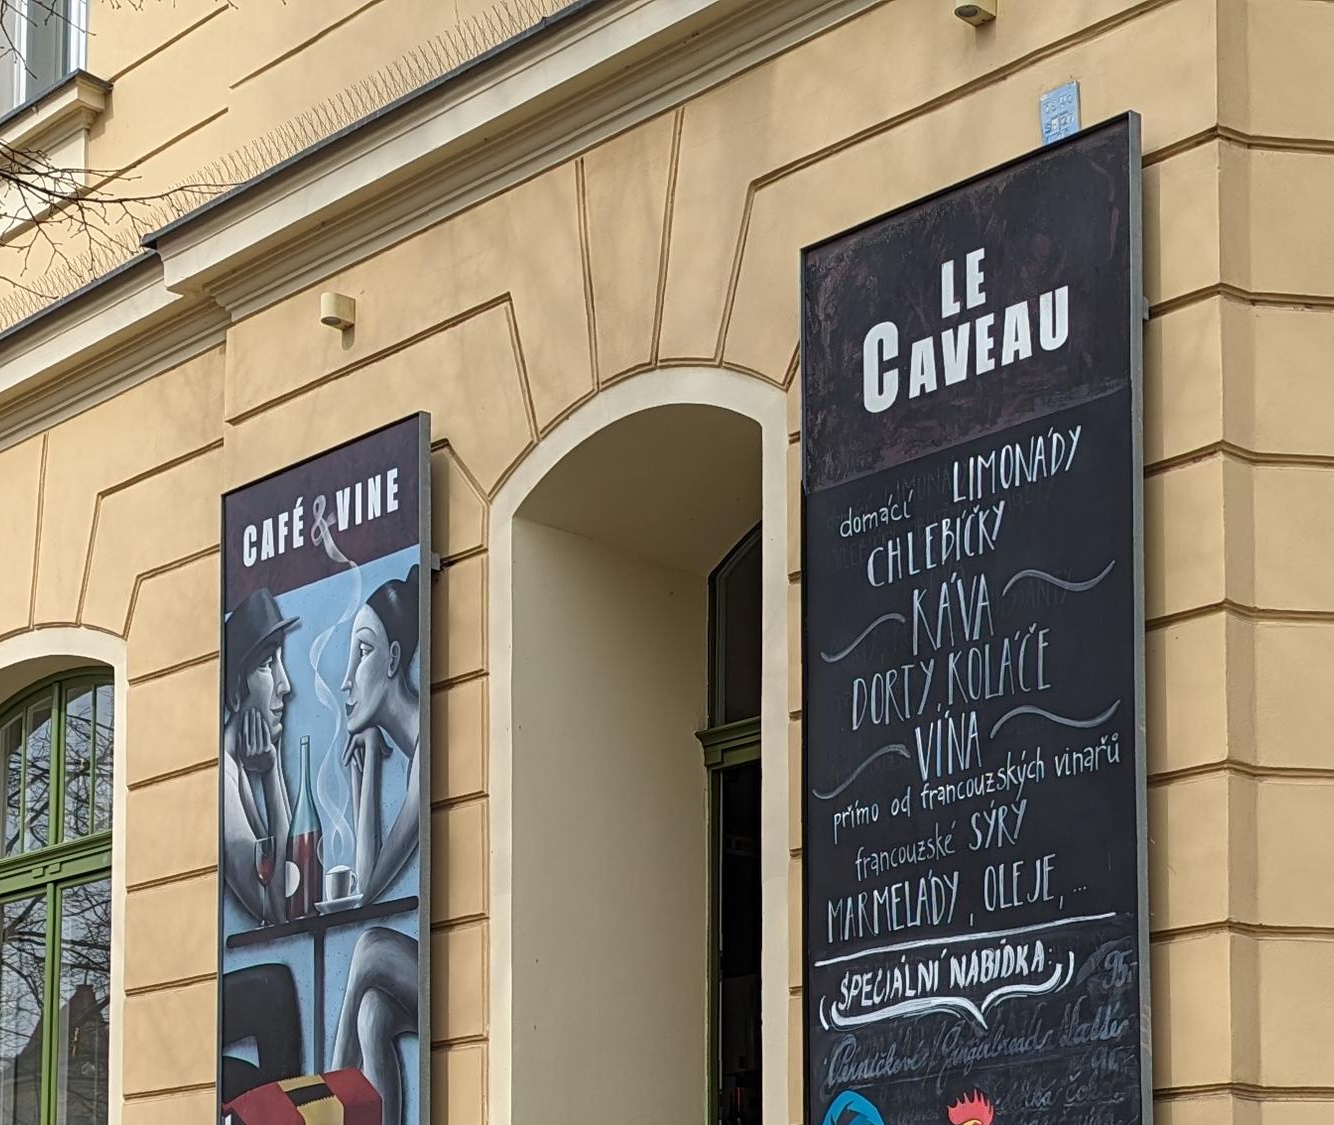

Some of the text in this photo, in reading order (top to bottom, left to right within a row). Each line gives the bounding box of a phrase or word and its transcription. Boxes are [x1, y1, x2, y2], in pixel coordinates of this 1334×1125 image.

[941, 248, 986, 319] LE
[863, 285, 1069, 413] CAVEAU
[243, 497, 304, 567] CAFÉ
[336, 468, 399, 532] VINE
[840, 425, 1082, 537] domácí LIMONÁDY
[867, 500, 1005, 588] CHLEBÍČKY
[913, 571, 995, 656] KÁVA
[852, 622, 1052, 731] DORTY KOLÁČE
[915, 702, 983, 781] VÍNA
[833, 732, 1121, 844] přímo od francouzských vinařů
[855, 799, 1028, 881] francouzské SÝRY
[839, 948, 947, 1012] SPECIÁLNÍ
